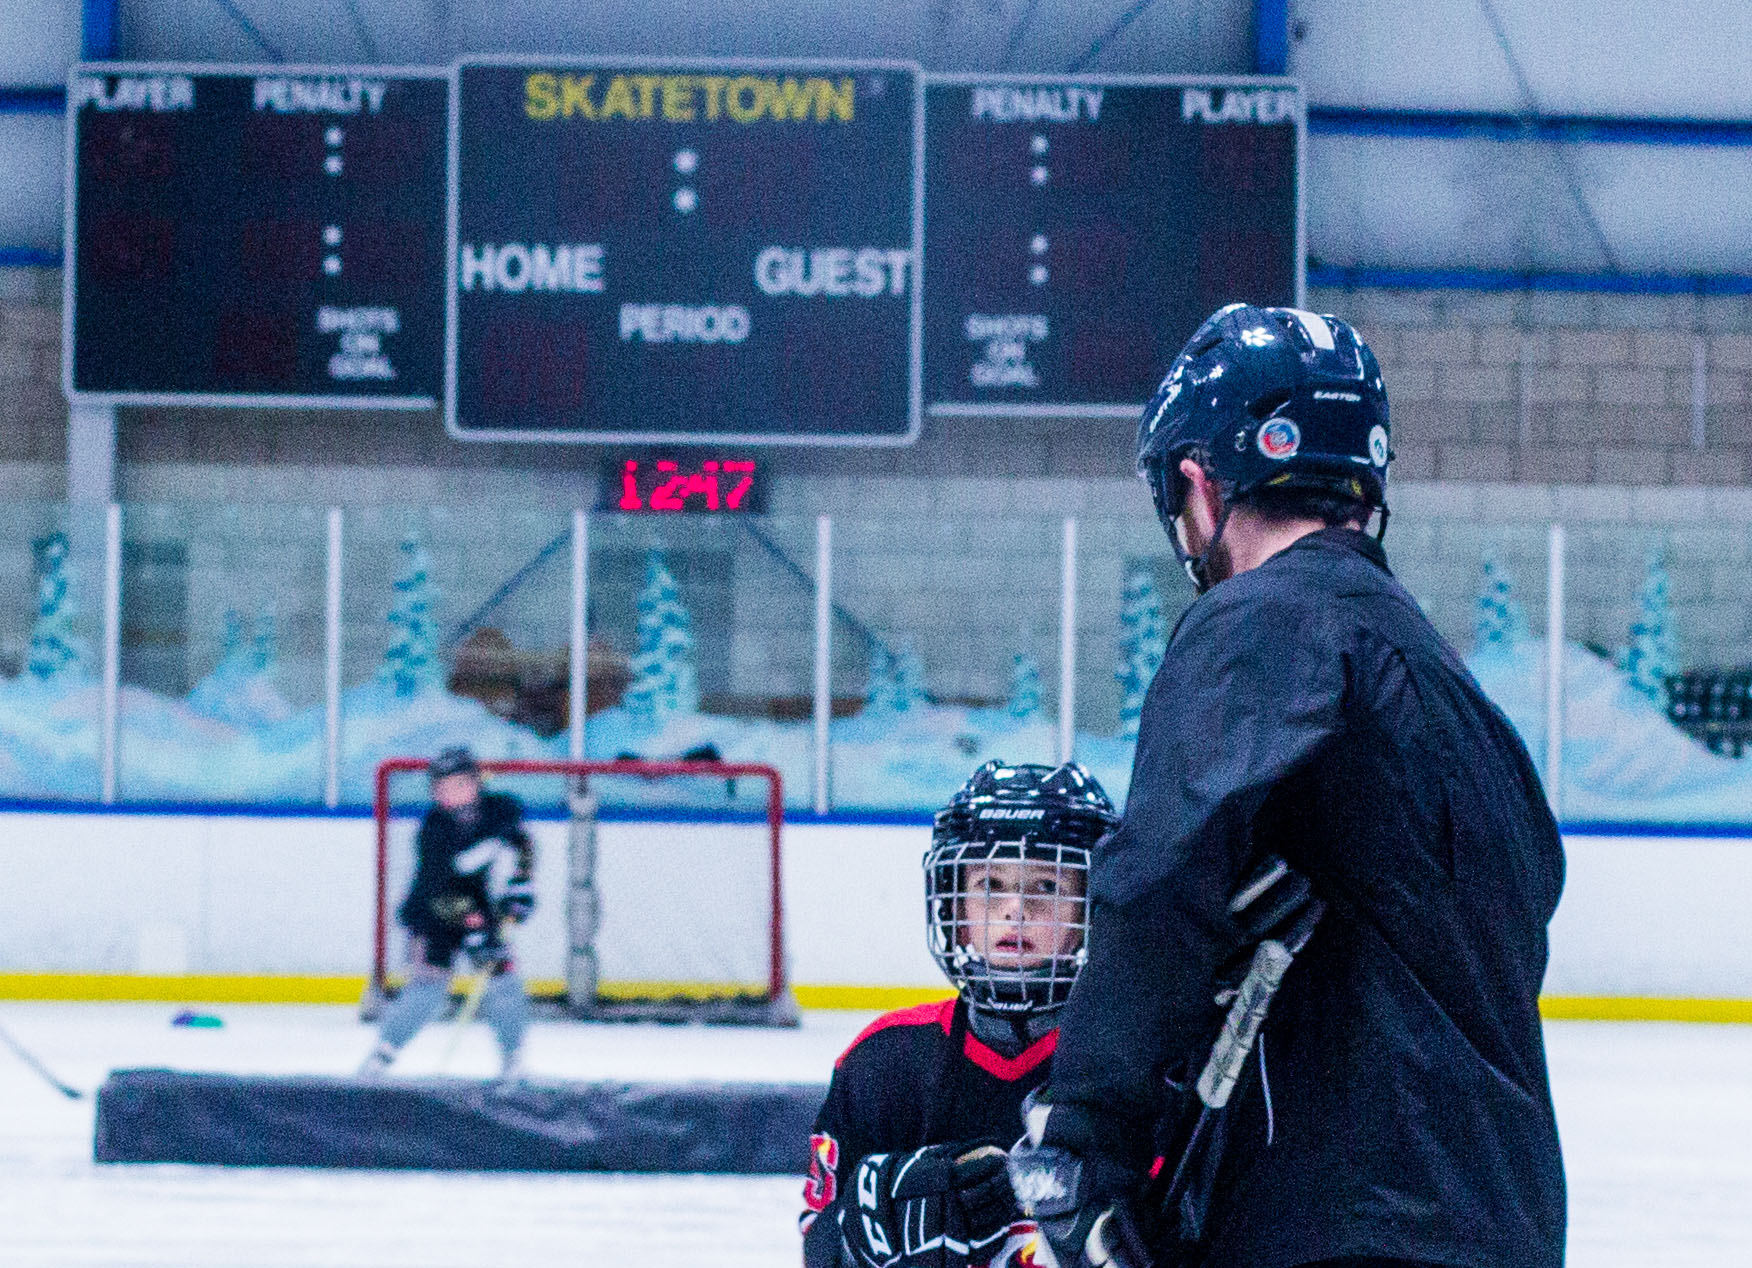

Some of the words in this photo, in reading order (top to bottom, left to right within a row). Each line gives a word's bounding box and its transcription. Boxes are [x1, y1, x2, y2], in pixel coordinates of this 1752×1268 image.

[78, 77, 195, 112] PLAYER
[253, 79, 387, 114] PENALTY
[524, 73, 855, 123] SKATETOWN
[972, 89, 1105, 122] PENALTY
[1182, 89, 1300, 123] PLAYER
[460, 243, 604, 293] HOME
[753, 247, 912, 297] GUEST
[619, 302, 752, 344] PERIOD
[979, 808, 1045, 820] BAUER
